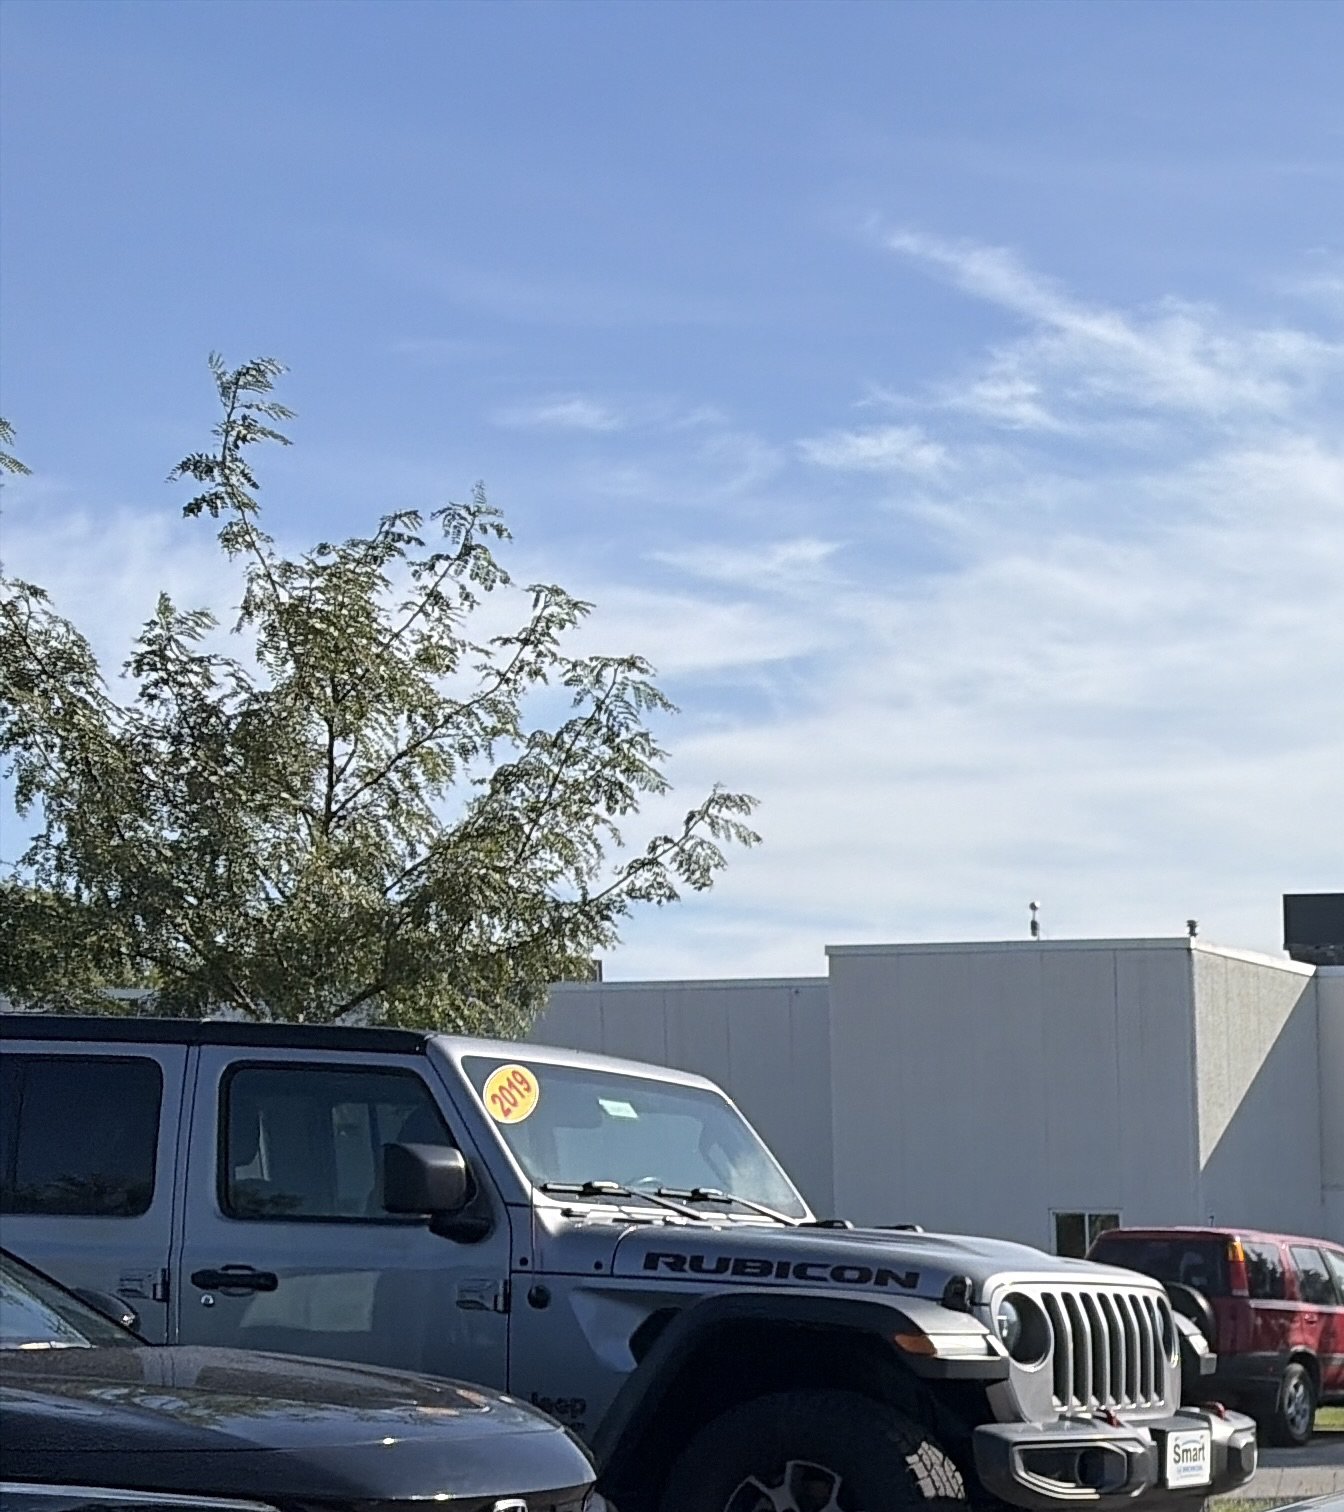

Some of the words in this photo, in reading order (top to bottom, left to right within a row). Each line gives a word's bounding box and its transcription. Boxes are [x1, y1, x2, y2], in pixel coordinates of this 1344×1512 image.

[491, 1070, 532, 1117] 2019
[643, 1253, 920, 1289] RUBICON
[1173, 1443, 1205, 1464] Smart
